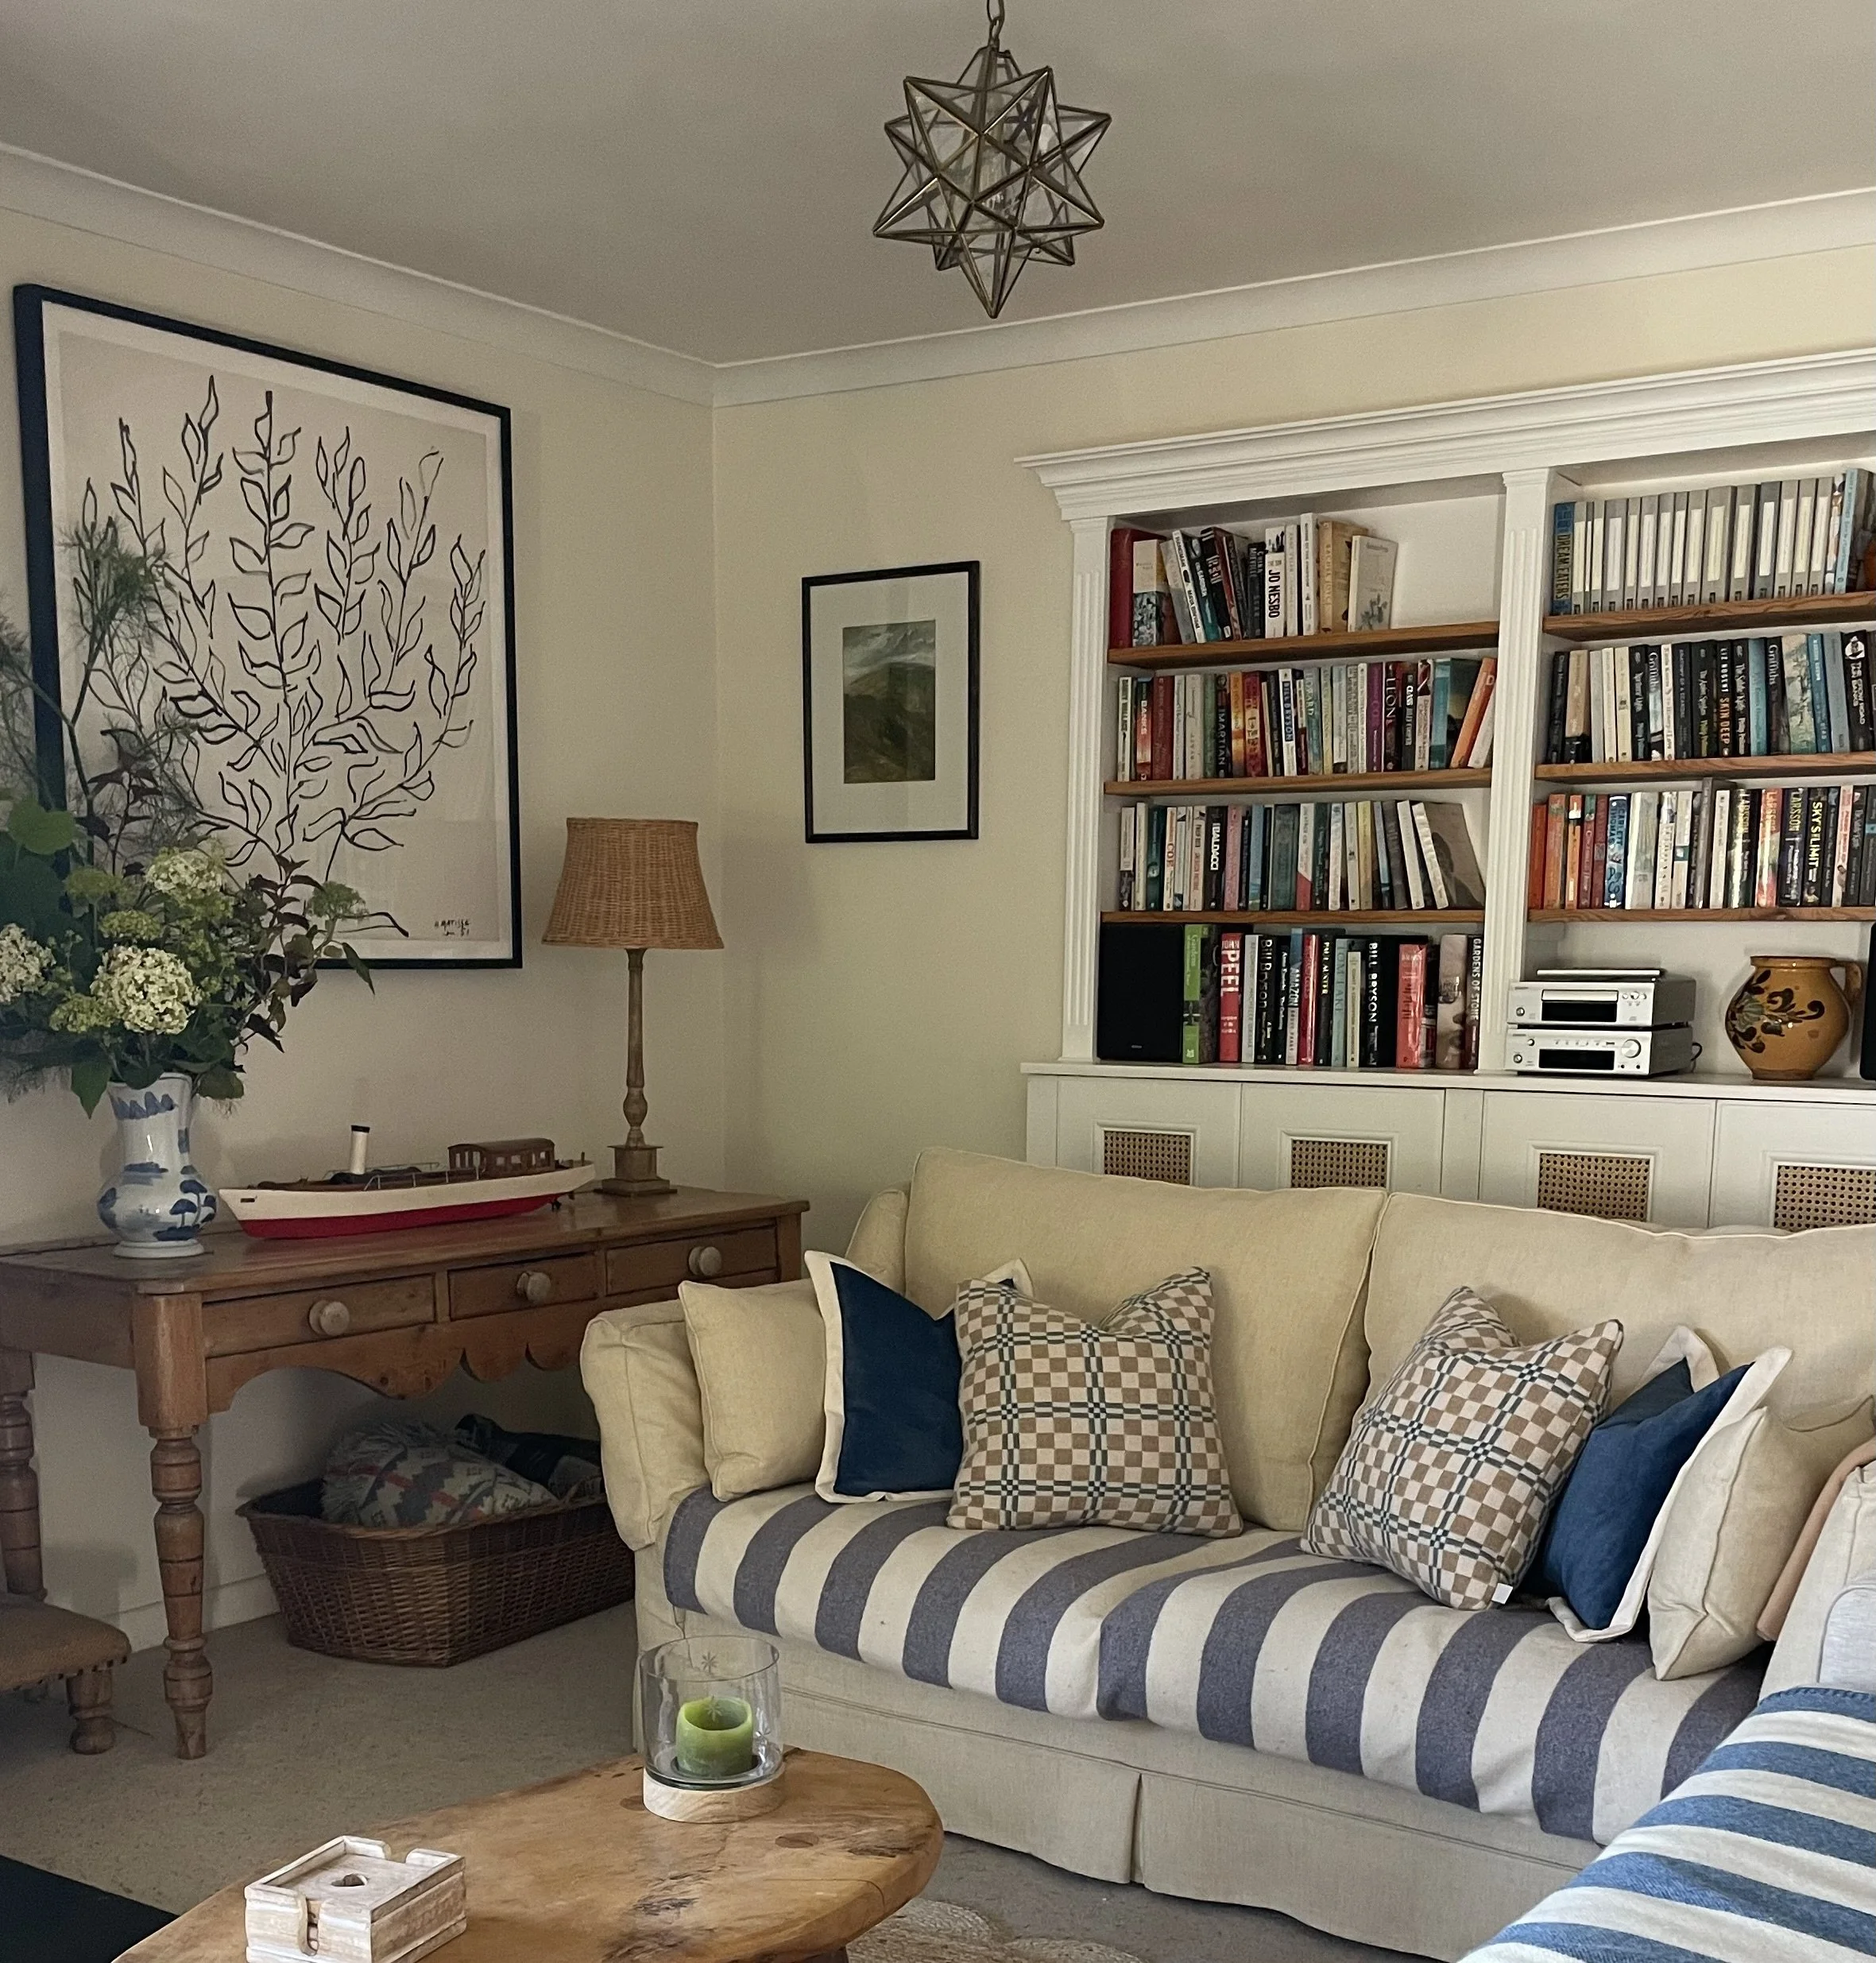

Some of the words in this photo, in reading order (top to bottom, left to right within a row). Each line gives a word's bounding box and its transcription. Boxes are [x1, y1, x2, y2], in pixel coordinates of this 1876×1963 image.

[1557, 533, 1571, 565] DREAM
[1269, 570, 1280, 582] JO
[1556, 568, 1569, 599] EATERS
[1768, 645, 1778, 685] Griffiths
[1284, 703, 1294, 741] BRYSON
[1719, 697, 1729, 718] SKIN
[1720, 721, 1730, 744] DEEP
[1789, 792, 1802, 831] LARSSON
[1811, 801, 1823, 833] SKY'S
[1808, 838, 1820, 868] LIMIT
[1190, 935, 1199, 966] Gardens
[1260, 939, 1273, 959] Bill
[1336, 947, 1346, 974] TOM
[1368, 943, 1379, 968] BILL
[1472, 938, 1482, 978] GARDENS
[1220, 950, 1240, 997] PEEL
[1258, 962, 1272, 1008] Bryson
[1288, 966, 1299, 1007] AMAZON
[1471, 980, 1480, 990] OF
[1368, 974, 1378, 1022] BRYSON
[1470, 993, 1479, 1020] STONE
